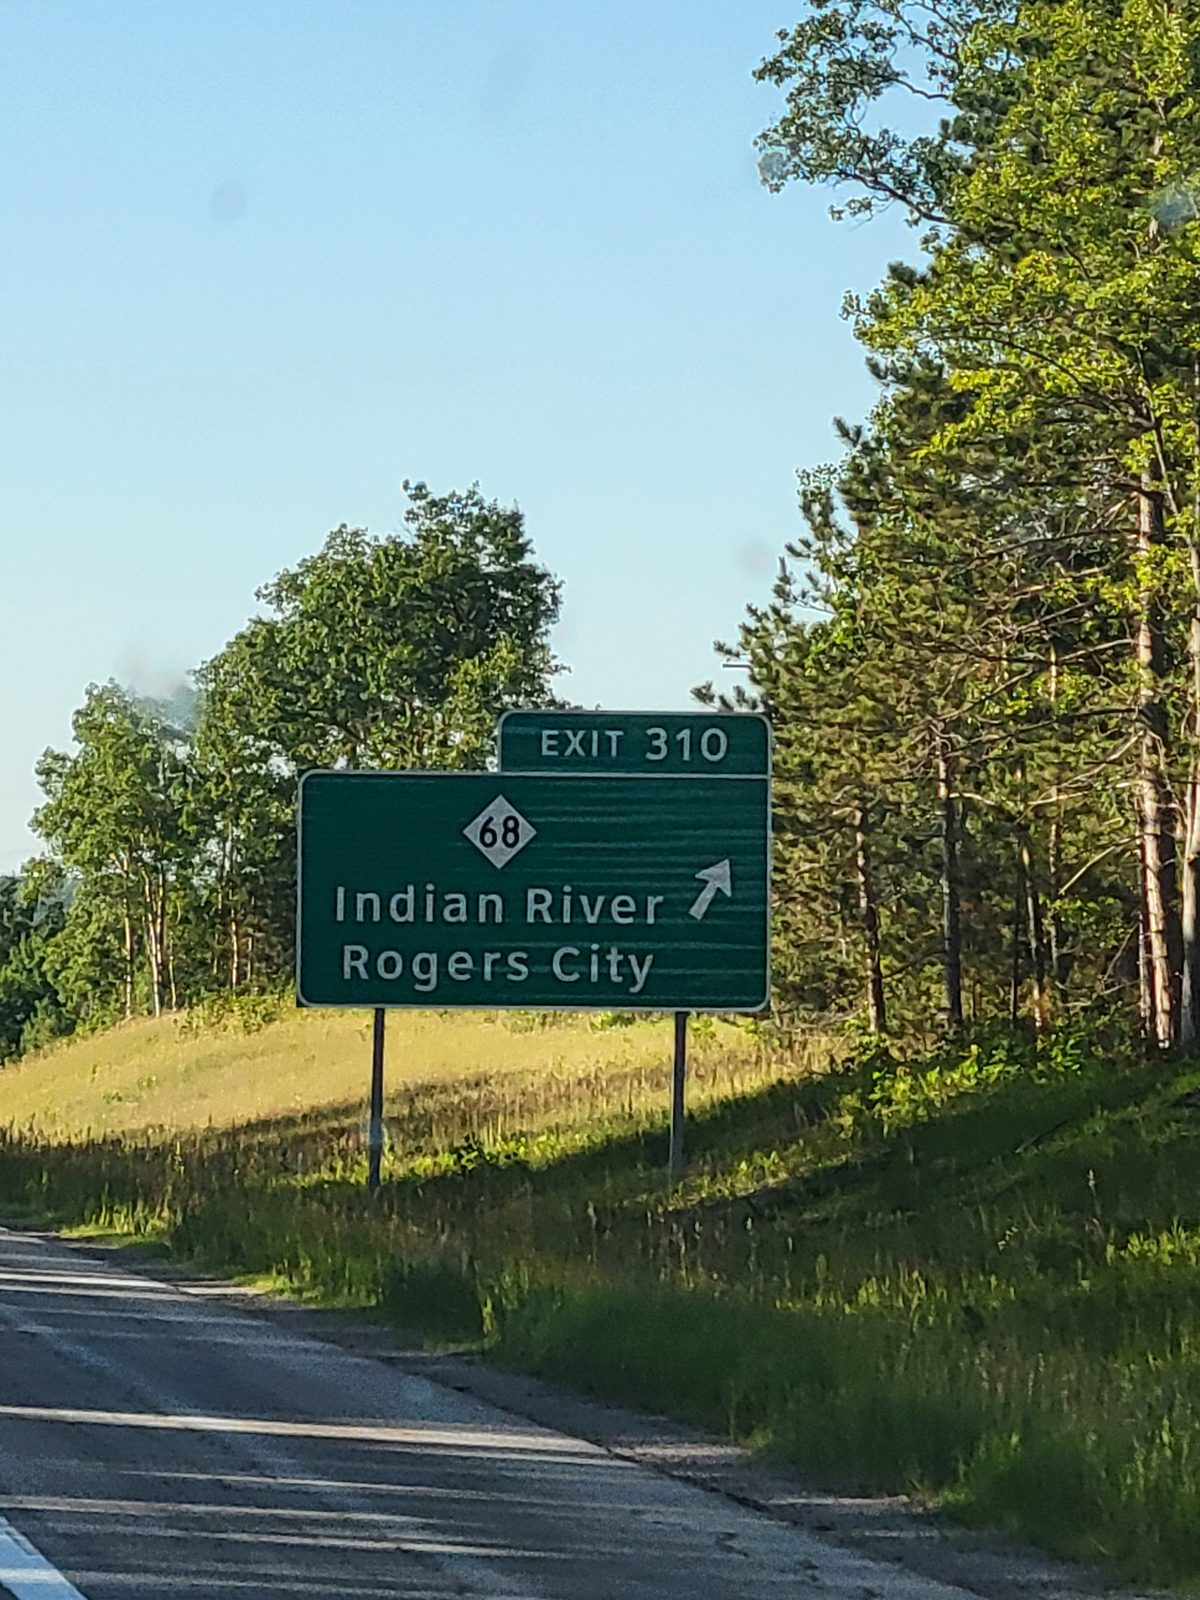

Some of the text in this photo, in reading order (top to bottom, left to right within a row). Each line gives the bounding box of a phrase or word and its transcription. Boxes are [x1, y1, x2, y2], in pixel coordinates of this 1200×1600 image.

[540, 727, 729, 762] EXIT 310
[478, 815, 520, 848] 68
[335, 883, 664, 925] Indian River
[342, 943, 654, 993] Rogers City
